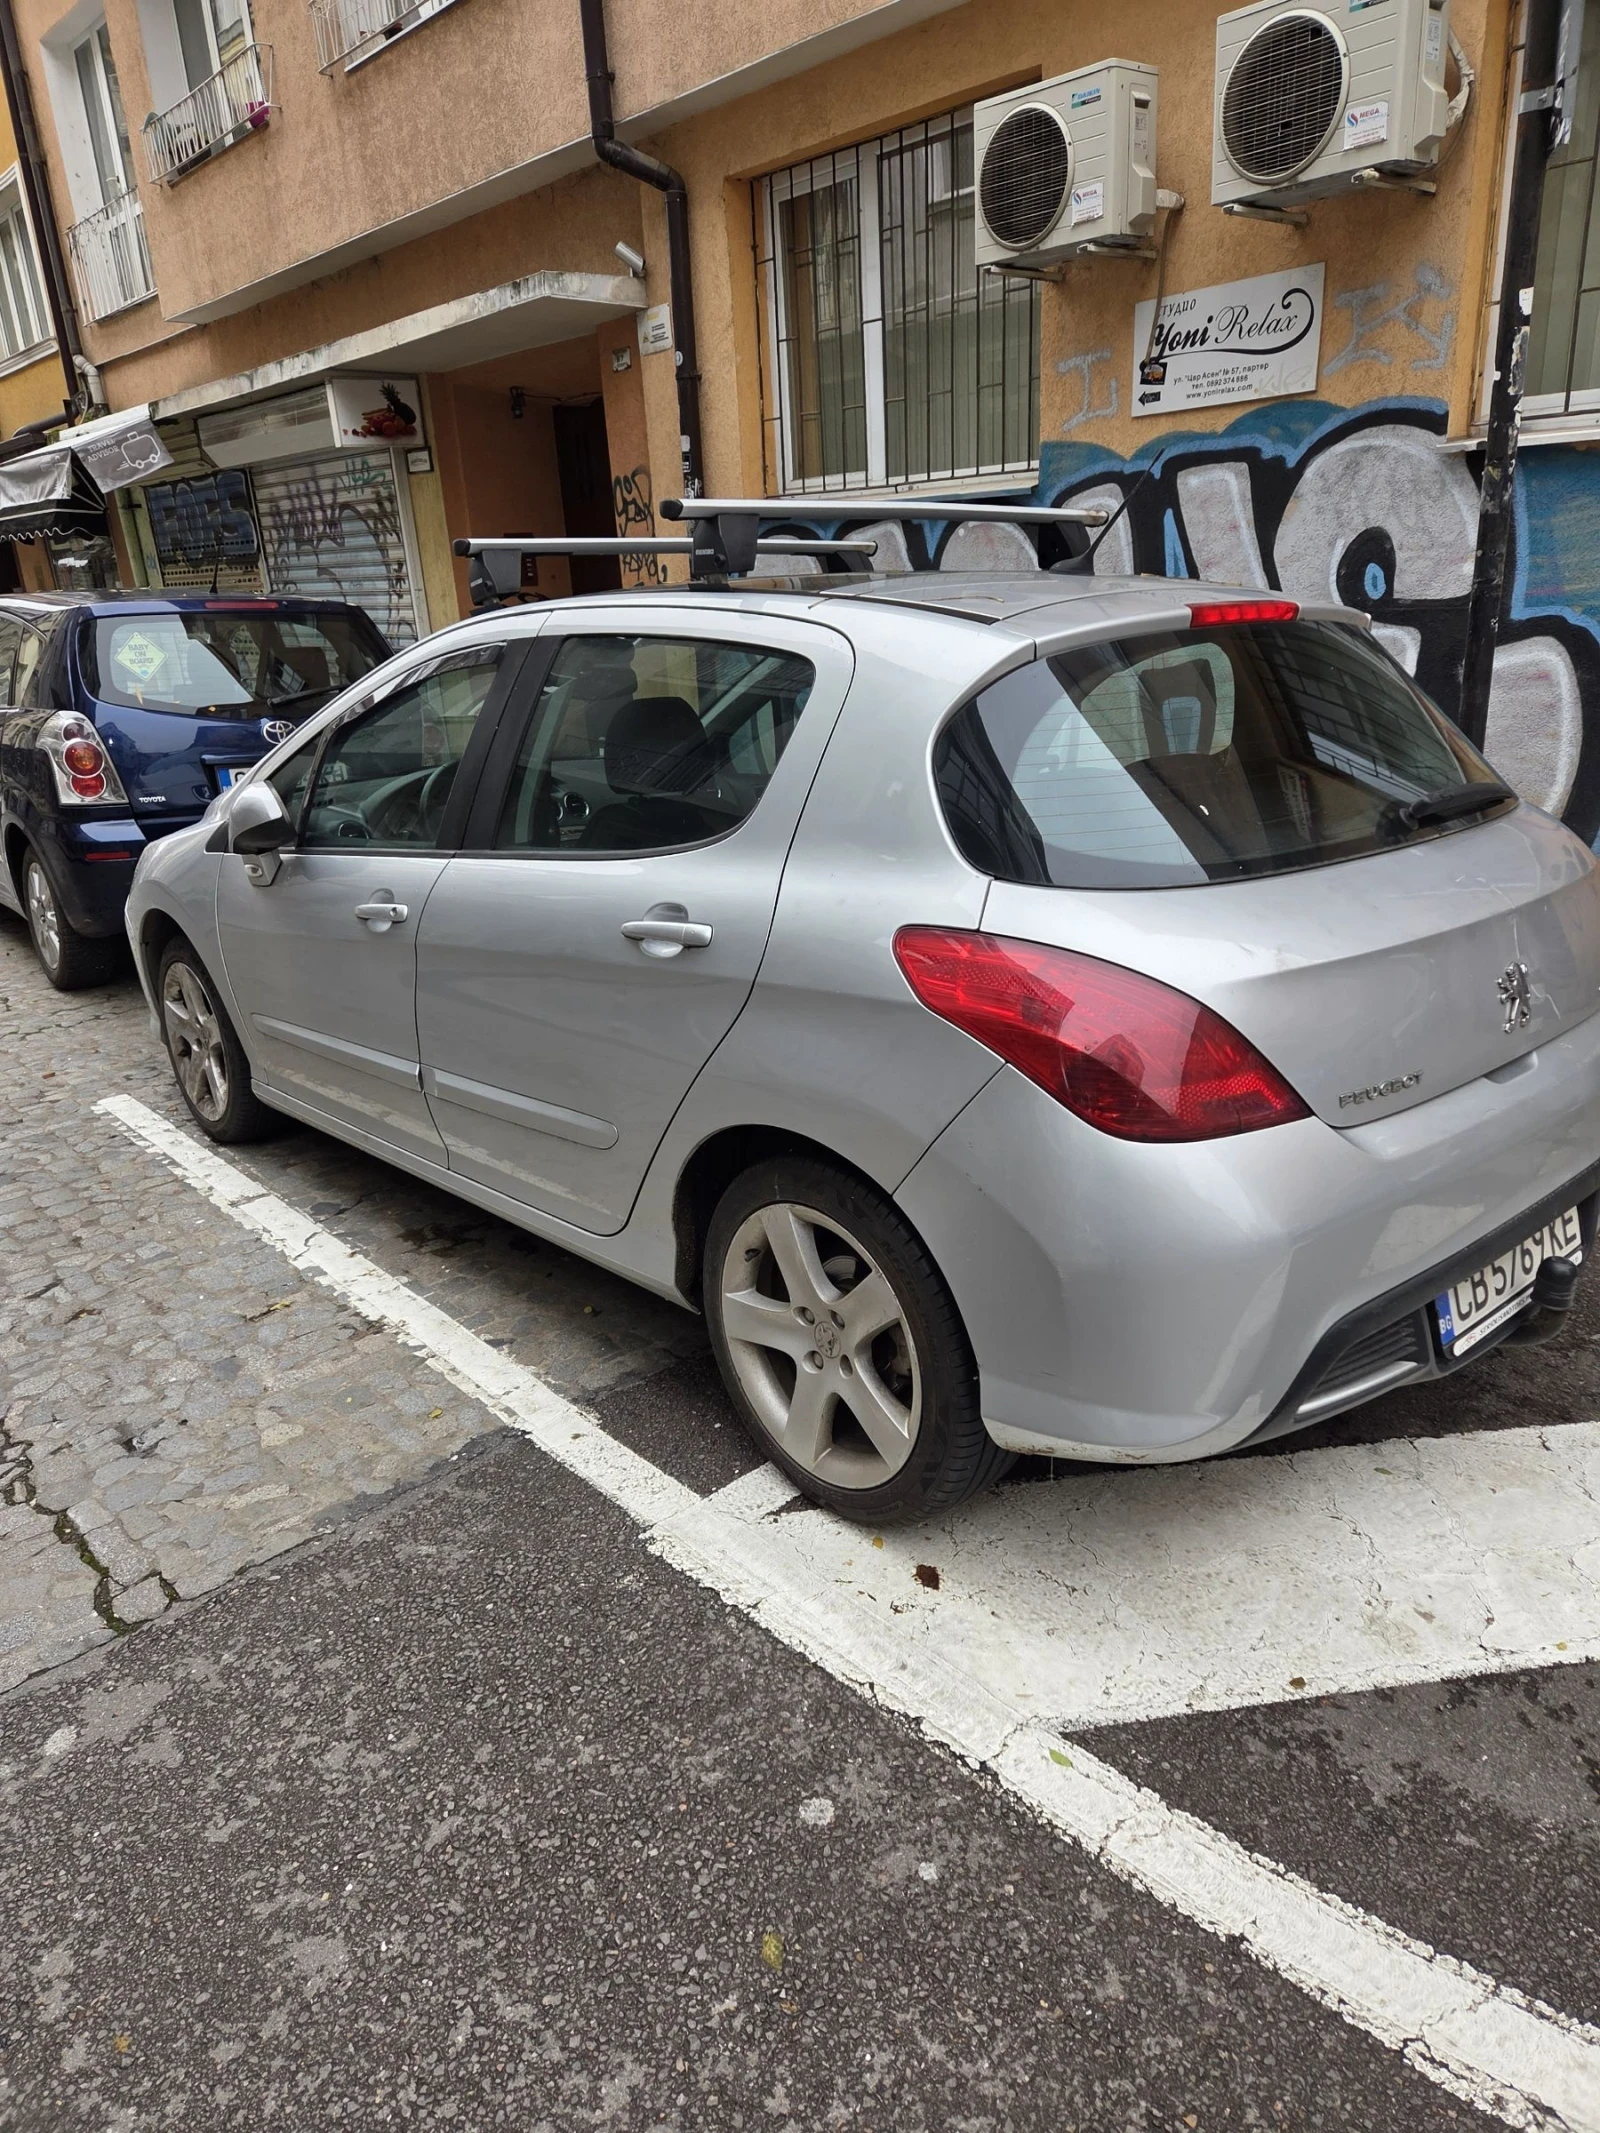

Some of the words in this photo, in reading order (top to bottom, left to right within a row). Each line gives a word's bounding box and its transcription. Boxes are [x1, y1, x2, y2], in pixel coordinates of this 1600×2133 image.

[1159, 298, 1197, 317] ТУДИО
[1154, 315, 1213, 358] Yoni
[1214, 302, 1298, 344] Relax
[1242, 362, 1269, 374] партер
[1222, 377, 1235, 386] 374
[1186, 383, 1253, 399] www.yonirelax.com
[87, 438, 116, 452] TRAVEL
[87, 445, 120, 463] ADVISOR
[138, 795, 166, 803] TOYOTA
[1338, 1069, 1424, 1109] PEUGEOT
[1438, 1315, 1452, 1335] BG
